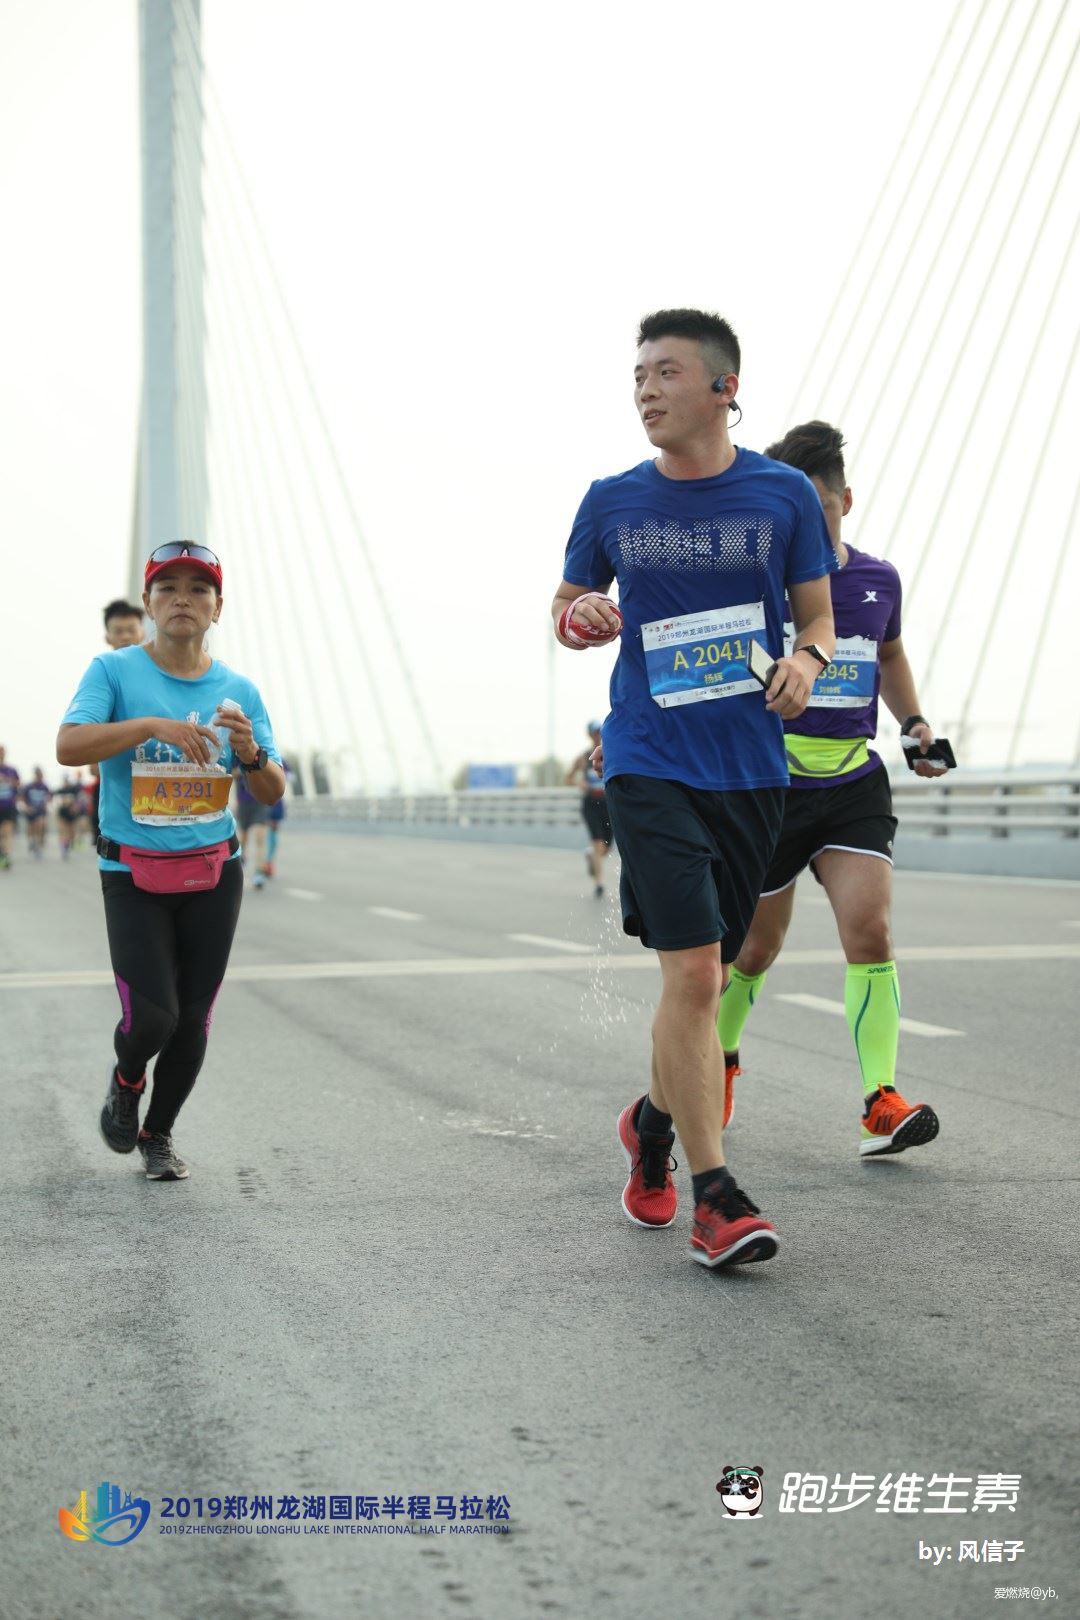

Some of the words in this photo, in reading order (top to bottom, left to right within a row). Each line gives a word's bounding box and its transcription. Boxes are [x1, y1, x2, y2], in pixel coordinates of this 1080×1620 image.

[674, 650, 690, 671] A
[692, 640, 746, 668] 2041
[155, 783, 167, 798] A
[172, 782, 213, 799] 3291
